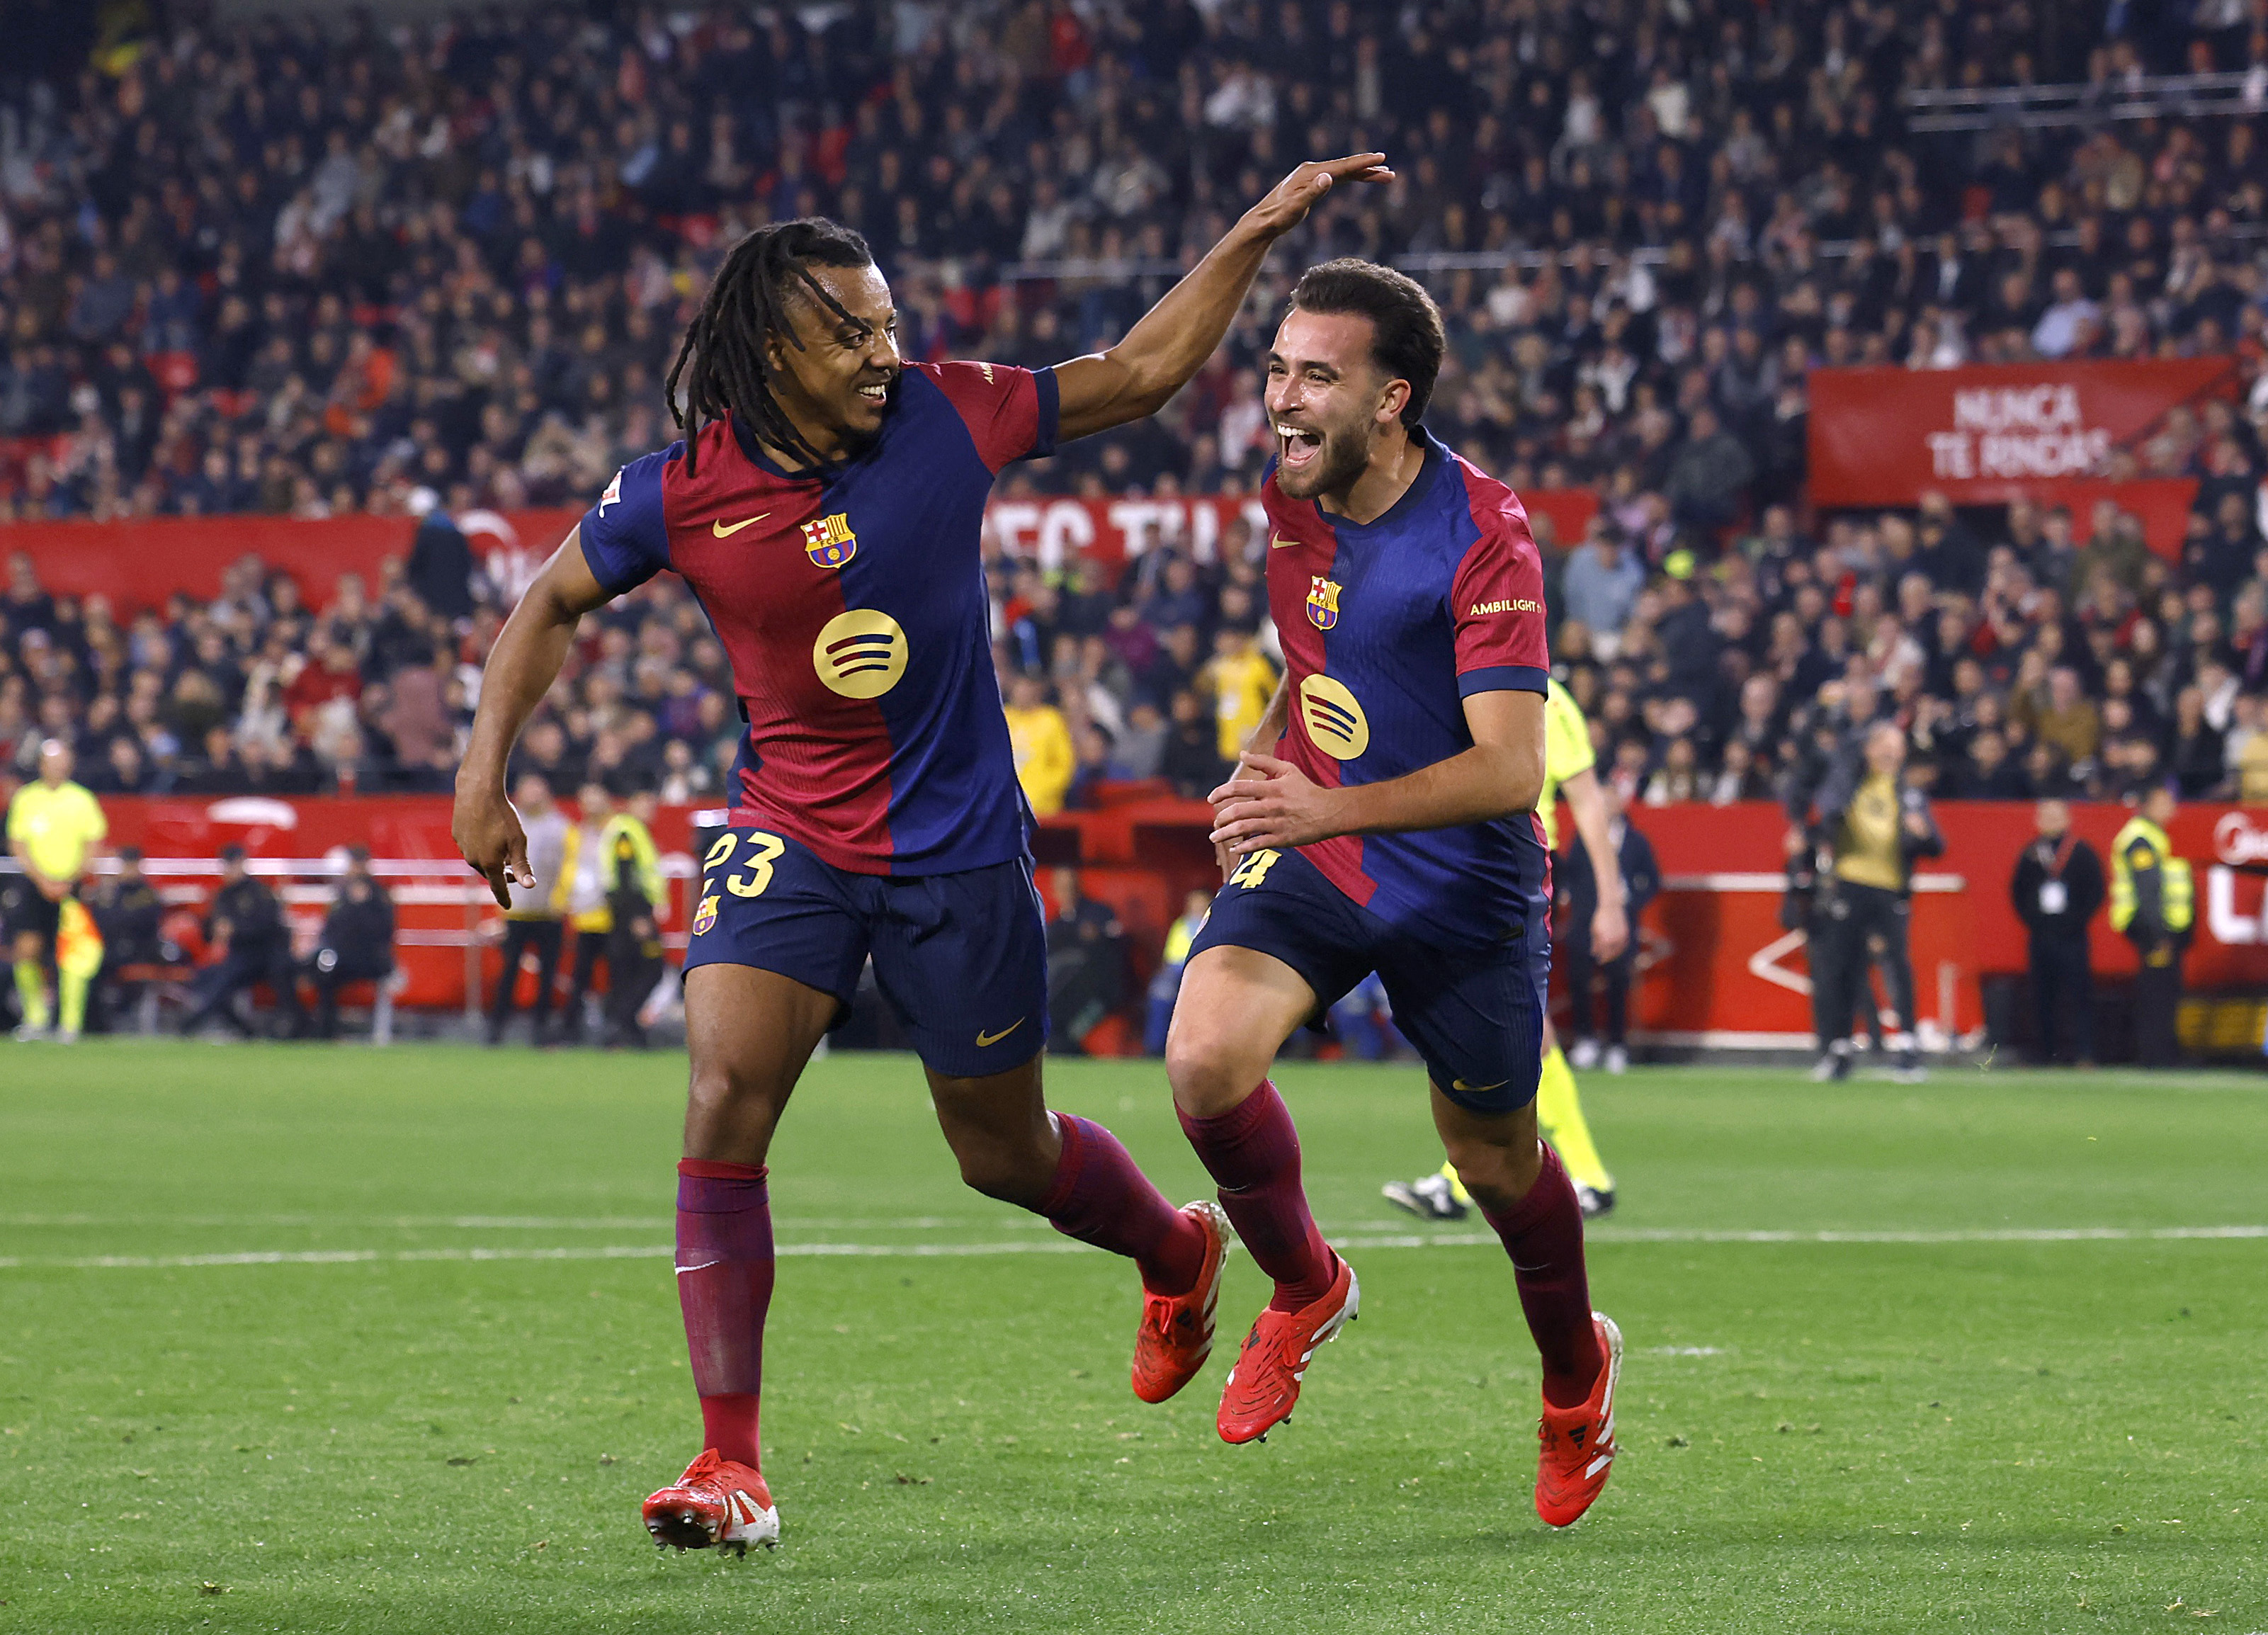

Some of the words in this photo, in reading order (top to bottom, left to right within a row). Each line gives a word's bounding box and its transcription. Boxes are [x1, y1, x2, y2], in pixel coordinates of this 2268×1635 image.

[1954, 383, 2082, 429] NUNCA
[1925, 431, 1973, 479] TE
[820, 536, 840, 548] FCB
[1316, 599, 1329, 609] FCB
[1470, 599, 1536, 616] AMBILIGHT
[702, 831, 786, 898] 23
